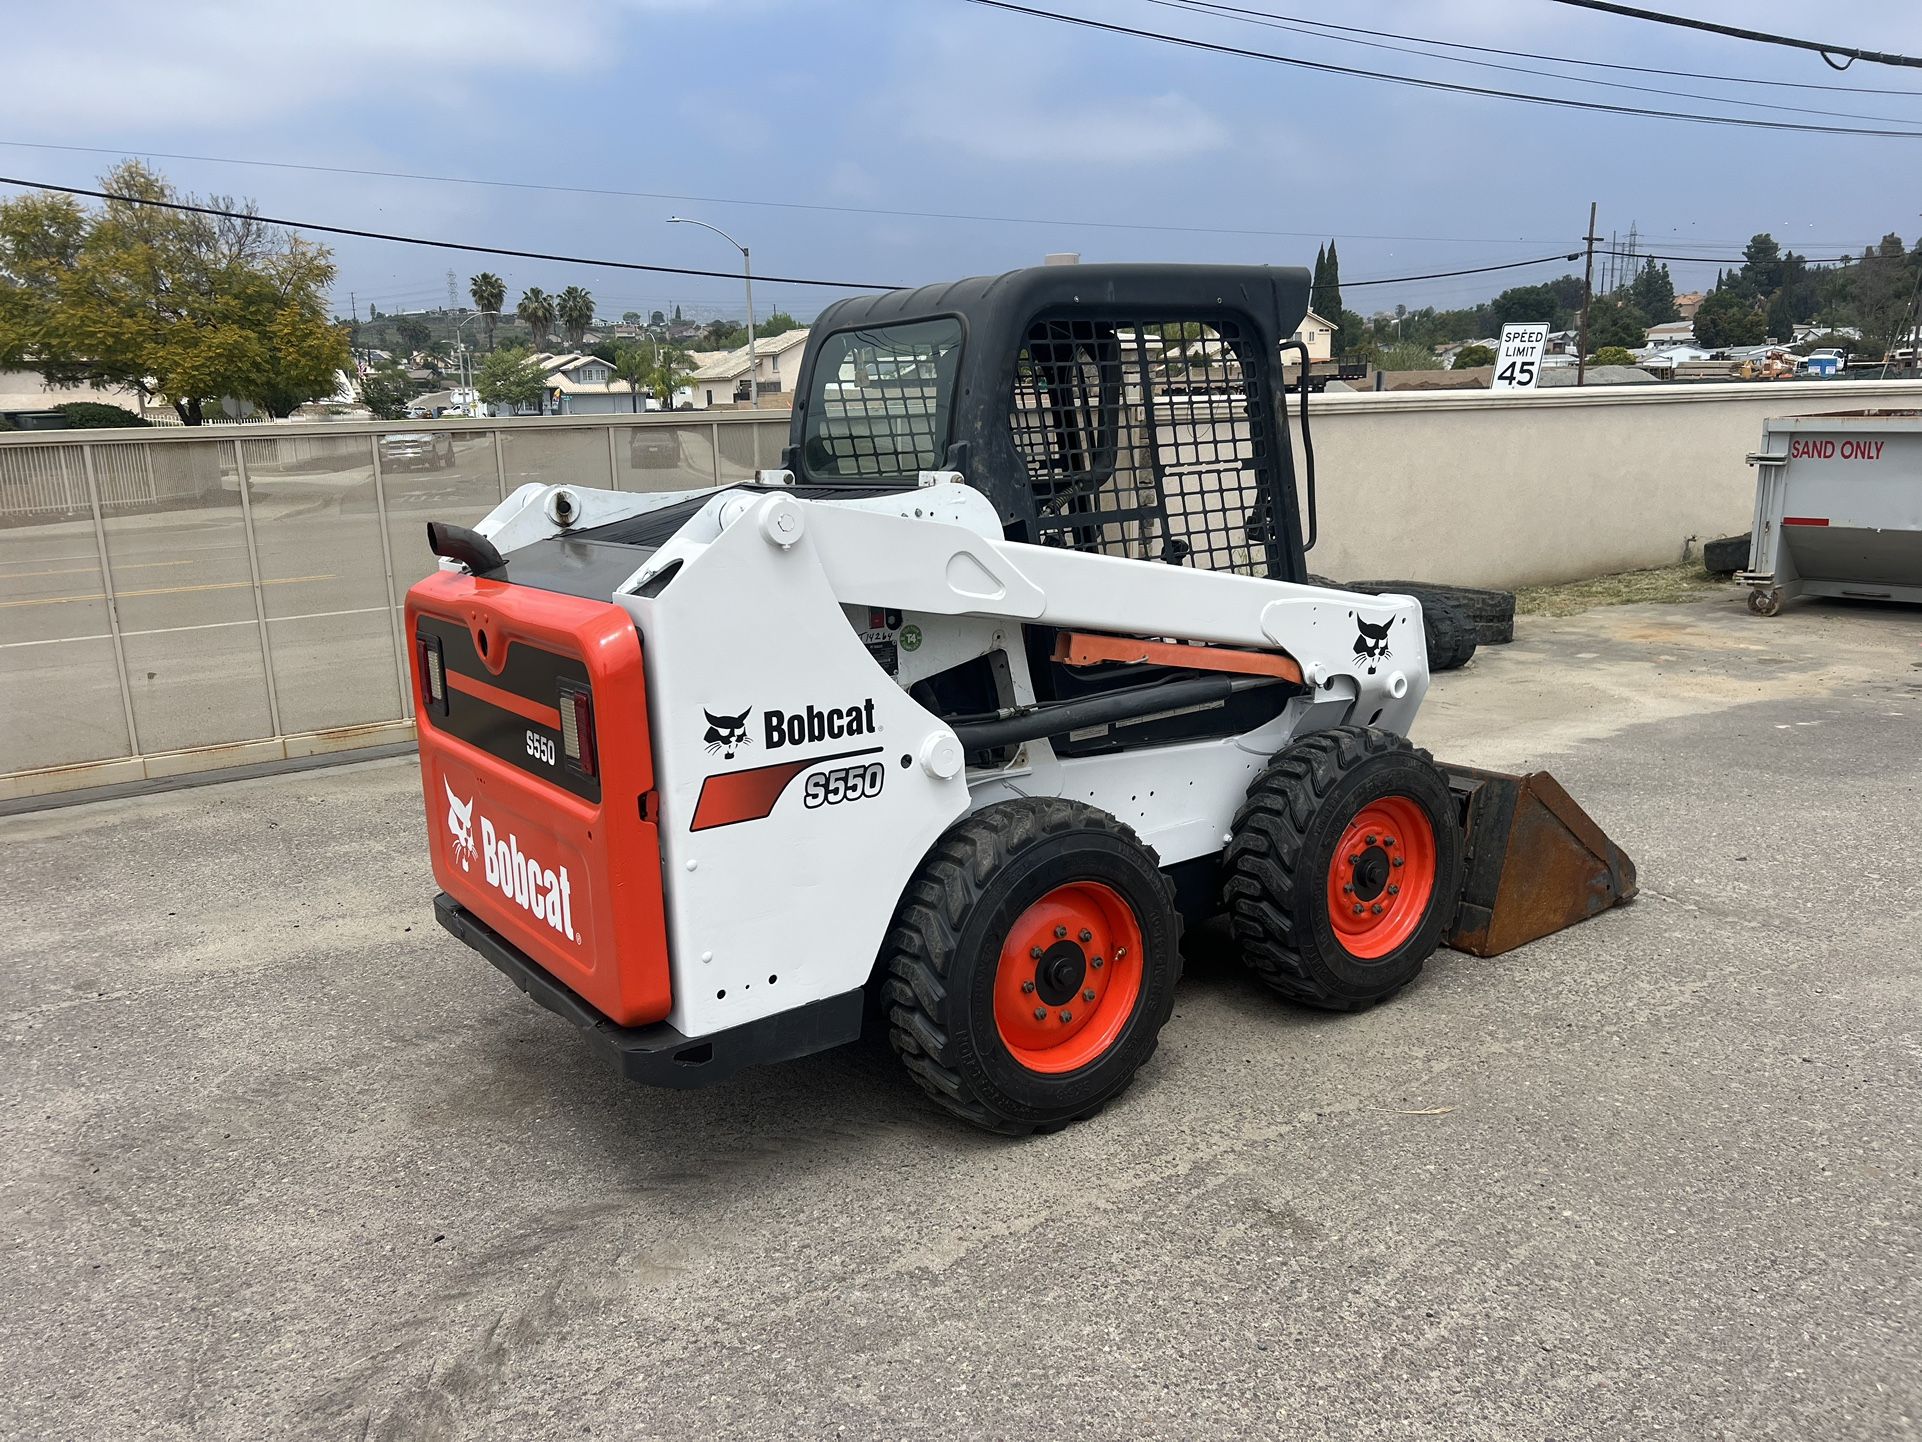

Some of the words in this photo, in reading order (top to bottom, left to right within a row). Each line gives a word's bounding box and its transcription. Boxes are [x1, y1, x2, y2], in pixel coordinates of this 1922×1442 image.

[1504, 331, 1544, 343] SPEED
[1505, 346, 1537, 358] LIMIT
[1497, 361, 1535, 387] 45
[1791, 439, 1836, 460] SAND
[1840, 440, 1885, 461] ONLY
[763, 697, 876, 750] Bobcat
[526, 730, 556, 766] S550
[803, 762, 885, 810] S550
[479, 815, 576, 942] Bobcat
